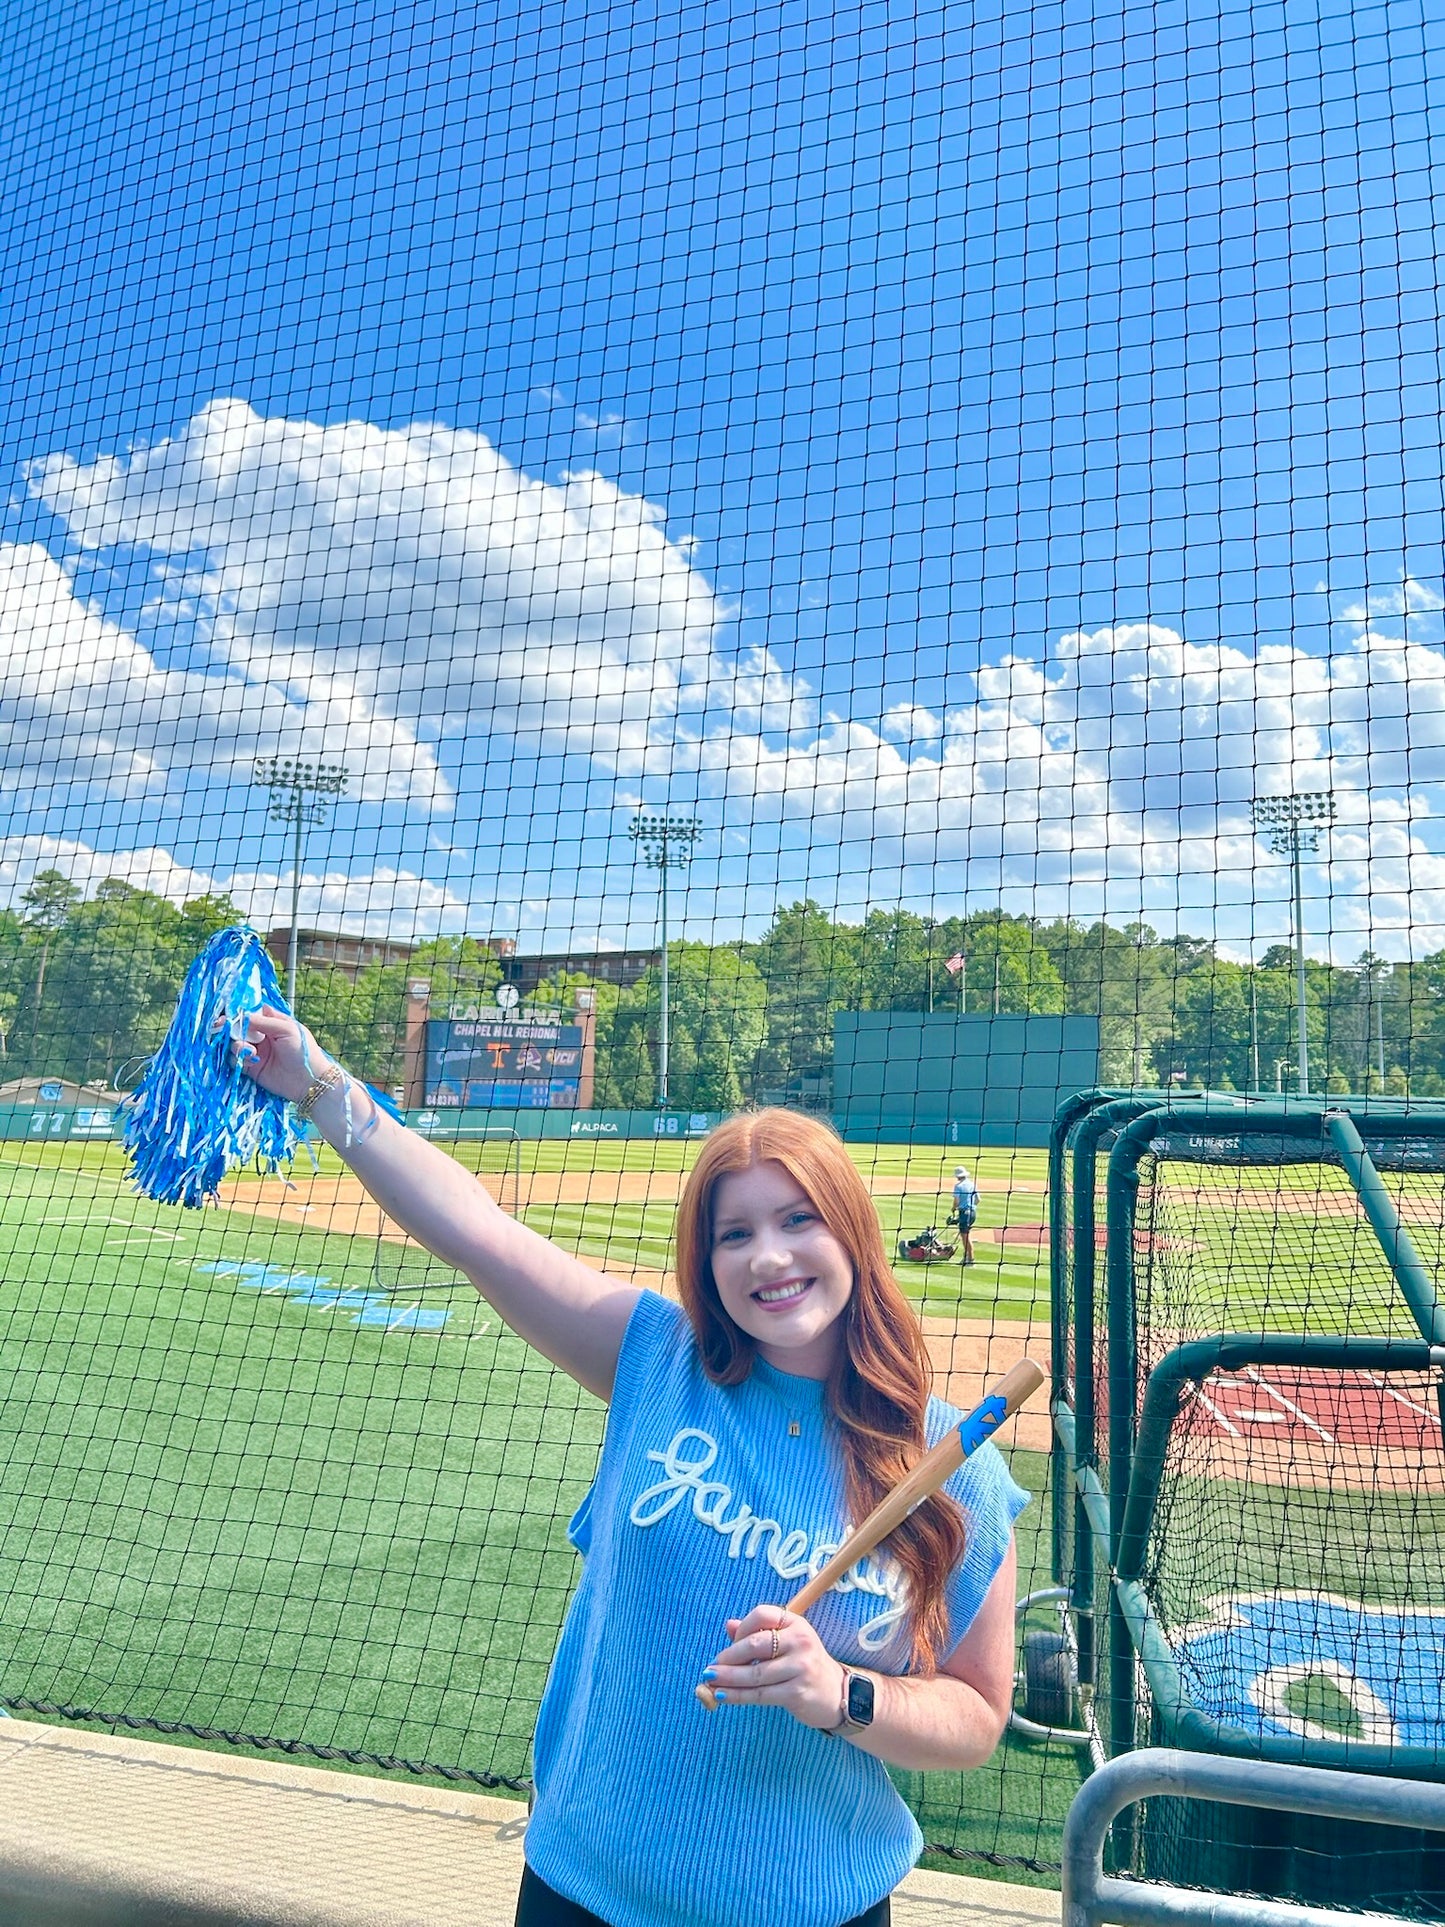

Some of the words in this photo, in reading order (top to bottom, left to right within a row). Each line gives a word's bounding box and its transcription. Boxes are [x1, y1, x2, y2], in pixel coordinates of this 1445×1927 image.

[449, 1004, 562, 1026] CAROLINA
[454, 1023, 491, 1037] CHAPEL
[493, 1026, 513, 1038] HILL
[515, 1027, 560, 1040] REGIONAL
[553, 1050, 577, 1064] VCU
[426, 1095, 447, 1106] 0403
[581, 1122, 618, 1132] ALPACA
